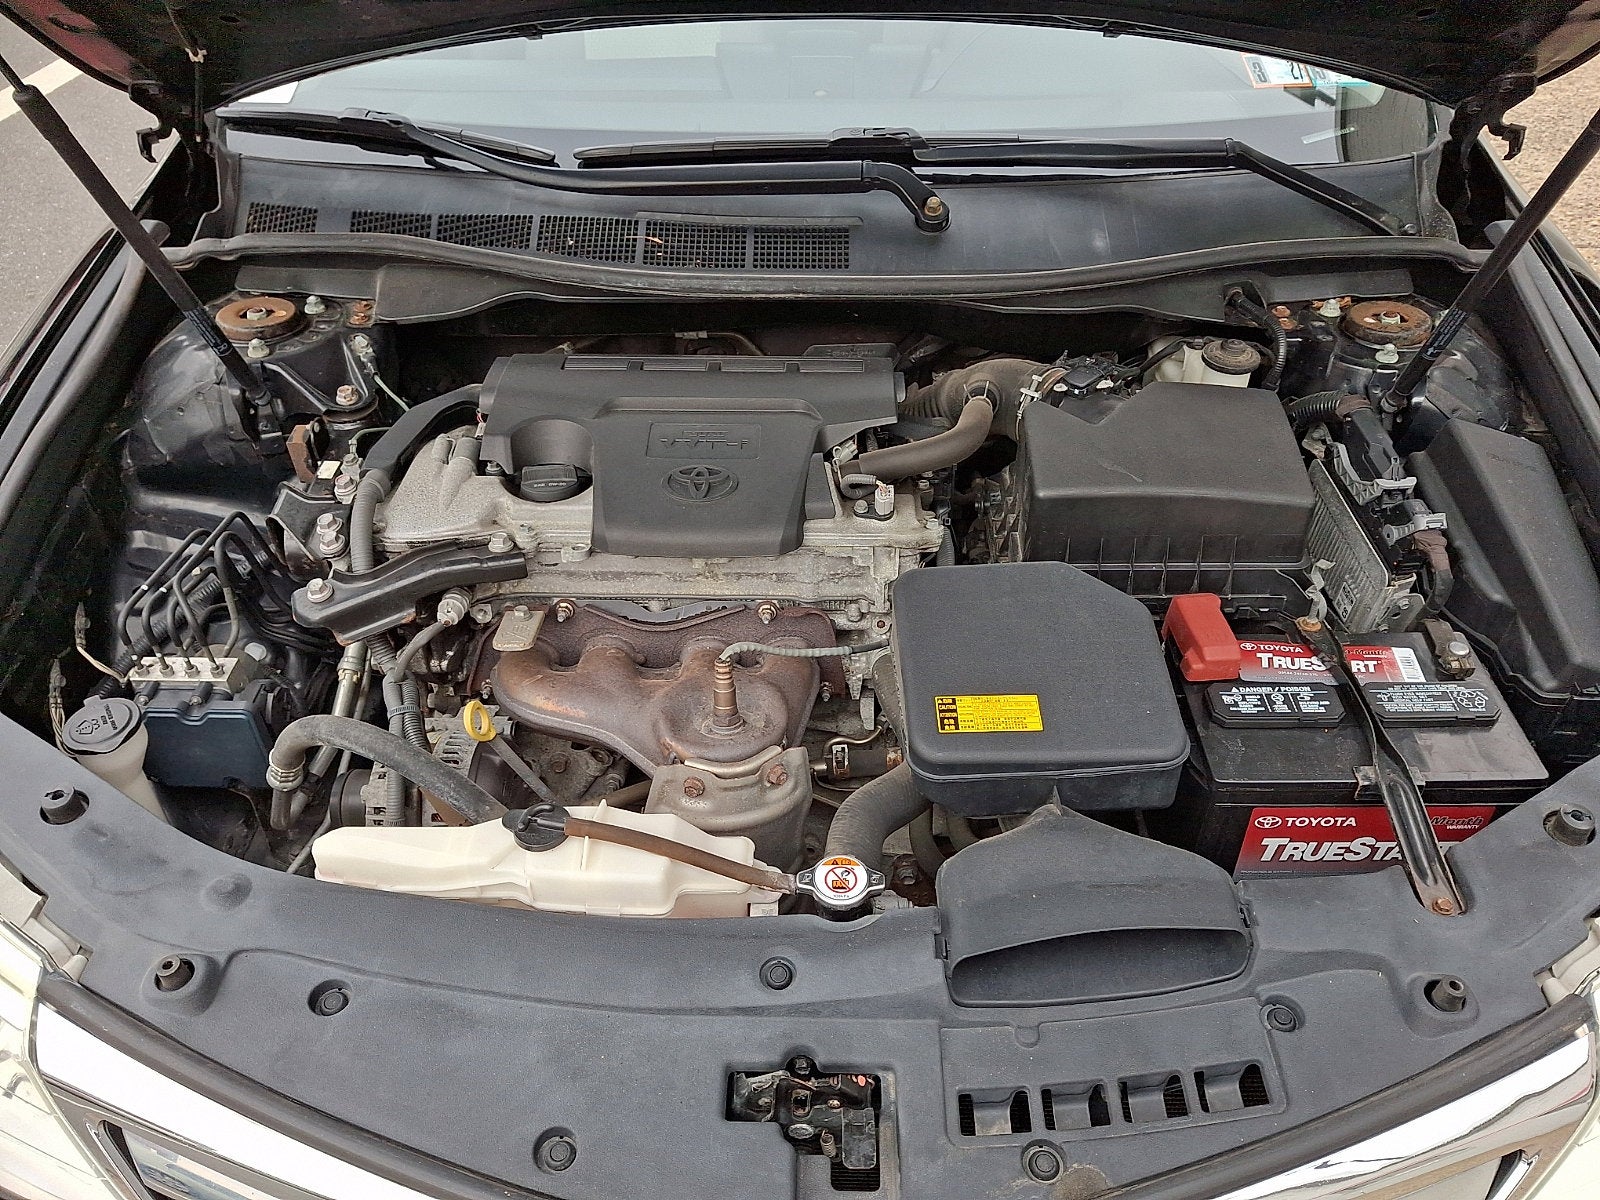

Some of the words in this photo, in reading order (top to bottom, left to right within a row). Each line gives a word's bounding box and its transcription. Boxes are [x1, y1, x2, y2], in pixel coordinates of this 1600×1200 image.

[1252, 61, 1268, 83] 3
[1258, 644, 1303, 653] TOYOTA
[1285, 816, 1357, 827] TOYOTA
